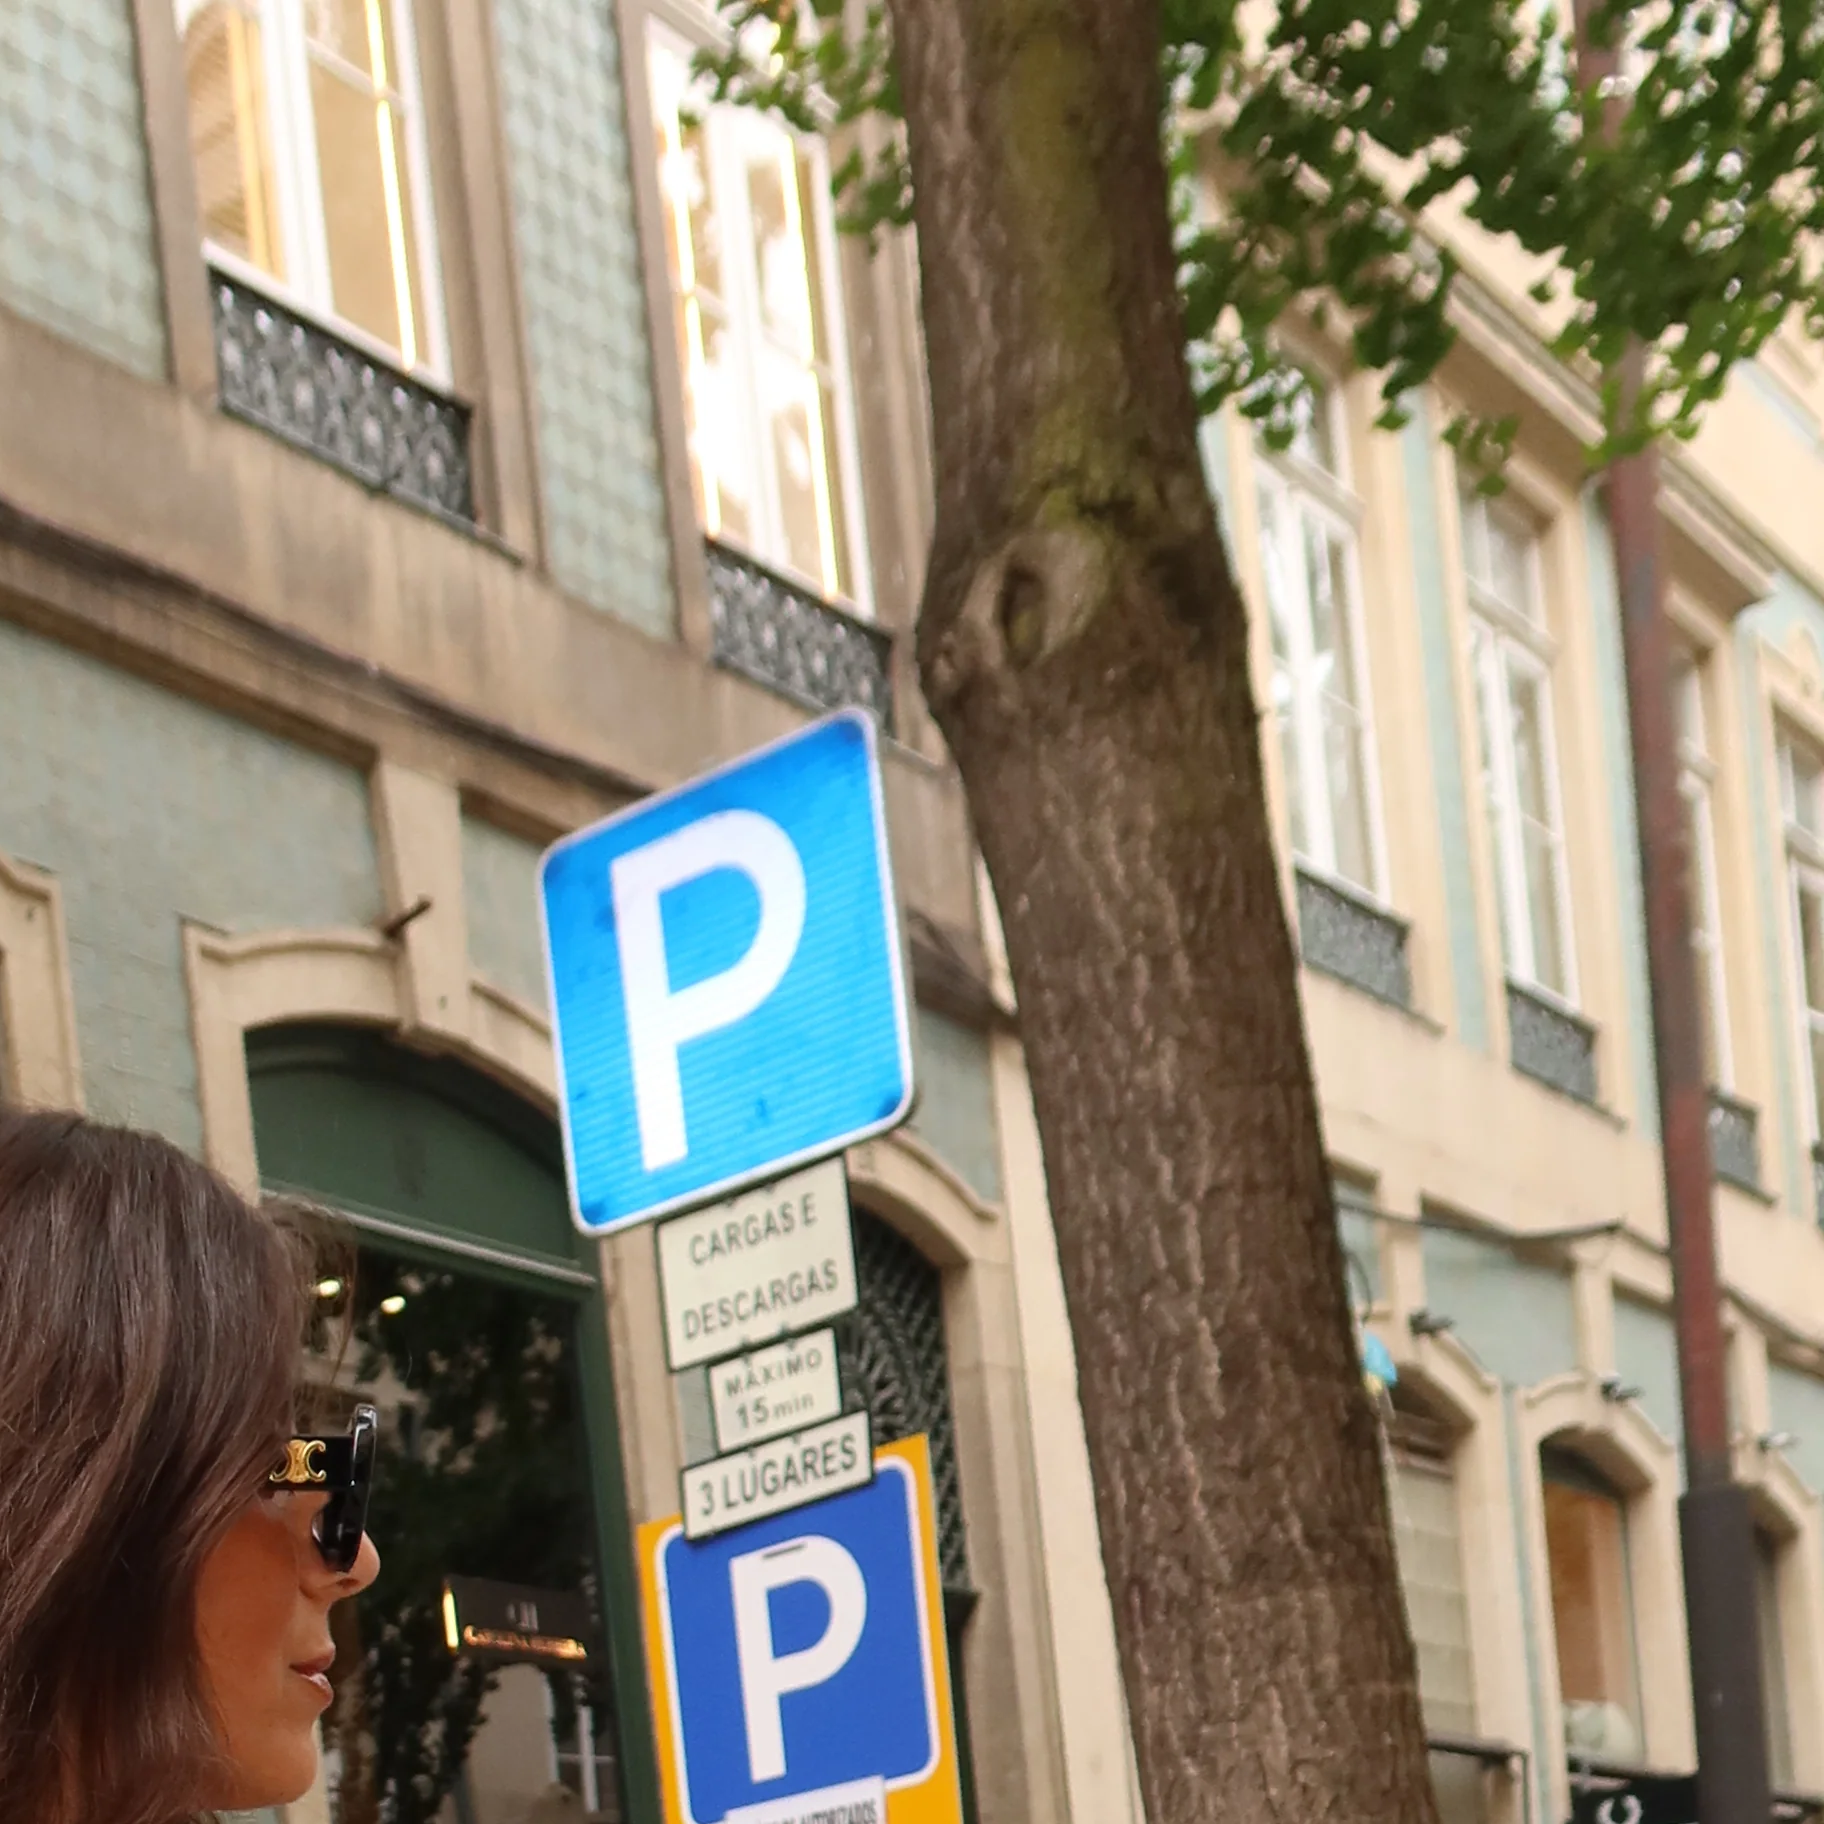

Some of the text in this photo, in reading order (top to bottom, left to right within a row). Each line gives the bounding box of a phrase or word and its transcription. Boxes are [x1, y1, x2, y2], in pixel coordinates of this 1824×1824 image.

[610, 809, 807, 1172] P
[688, 1193, 818, 1266] CARGAS E
[682, 1258, 838, 1339] DESCARGAS
[736, 1393, 814, 1430] 15 min
[699, 1434, 857, 1516] 3 LUGARES
[729, 1535, 867, 1783] P
